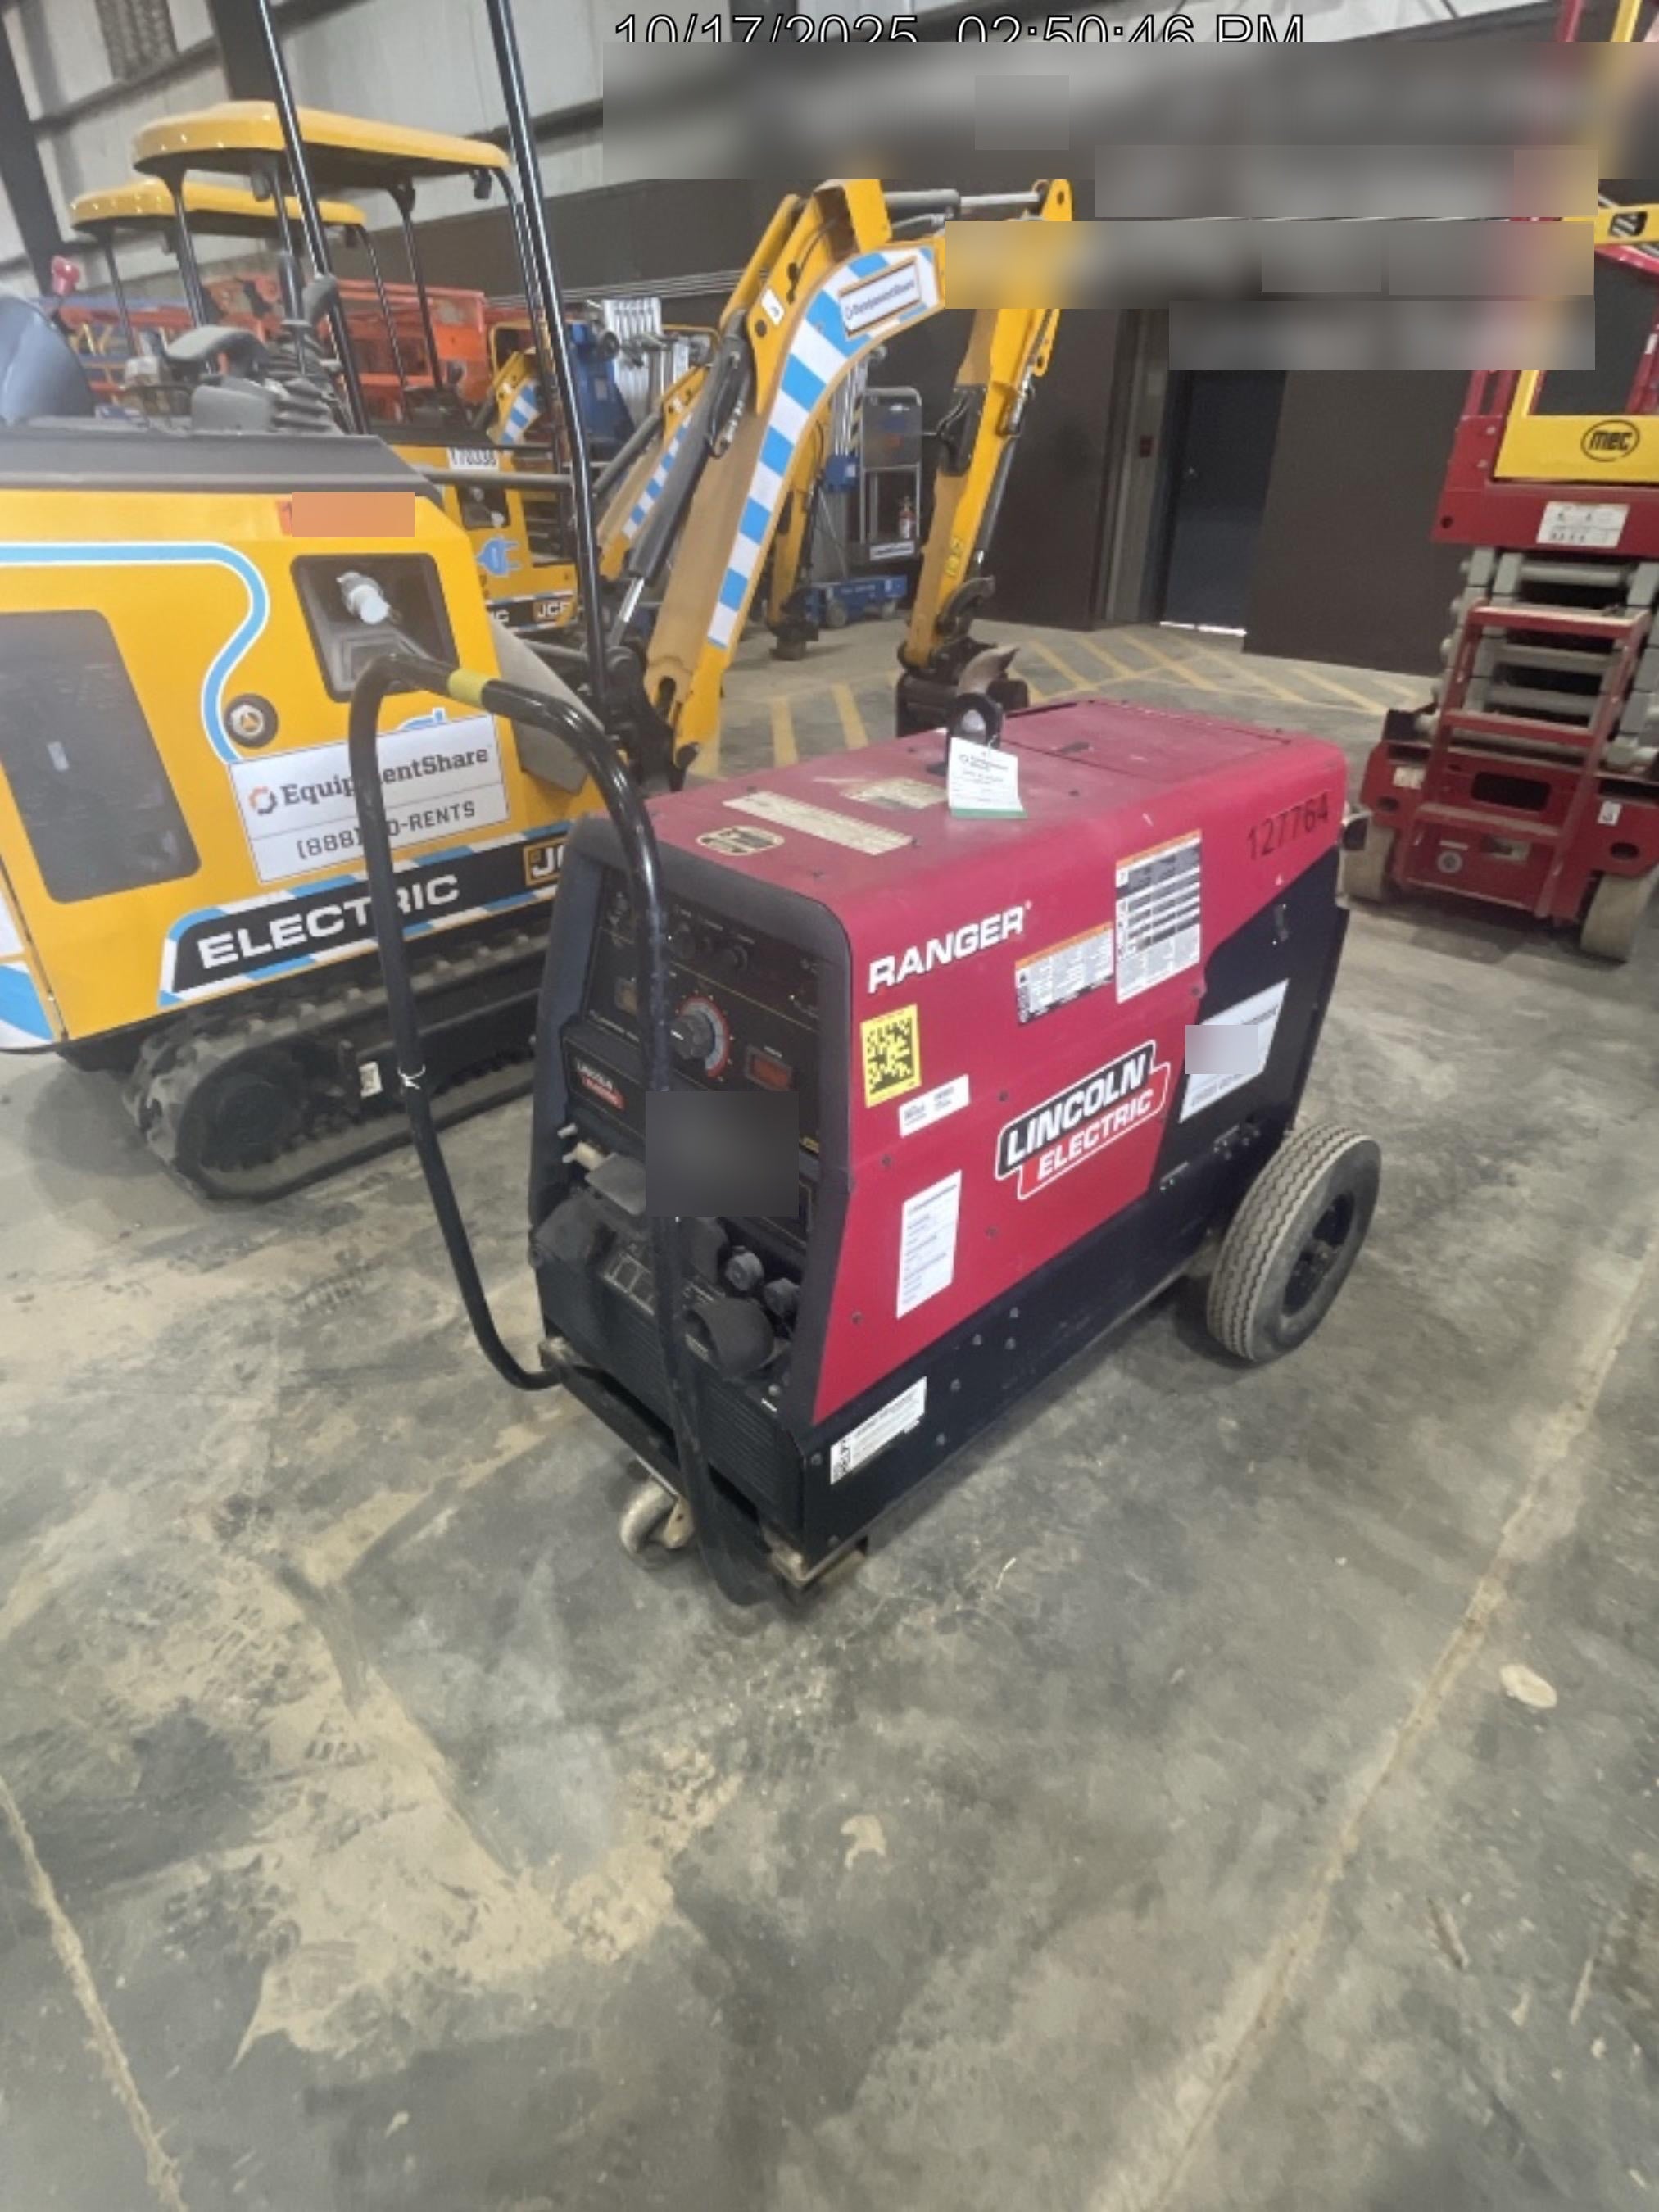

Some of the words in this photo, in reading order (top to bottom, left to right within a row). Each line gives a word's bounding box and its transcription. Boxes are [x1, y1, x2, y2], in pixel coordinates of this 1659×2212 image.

[279, 748, 489, 805] EquipentShare
[1248, 791, 1329, 861] 127764
[868, 905, 1024, 994] RANGER
[1007, 1054, 1146, 1166] LINCOLN
[1037, 1088, 1154, 1180] ELECTRIC
